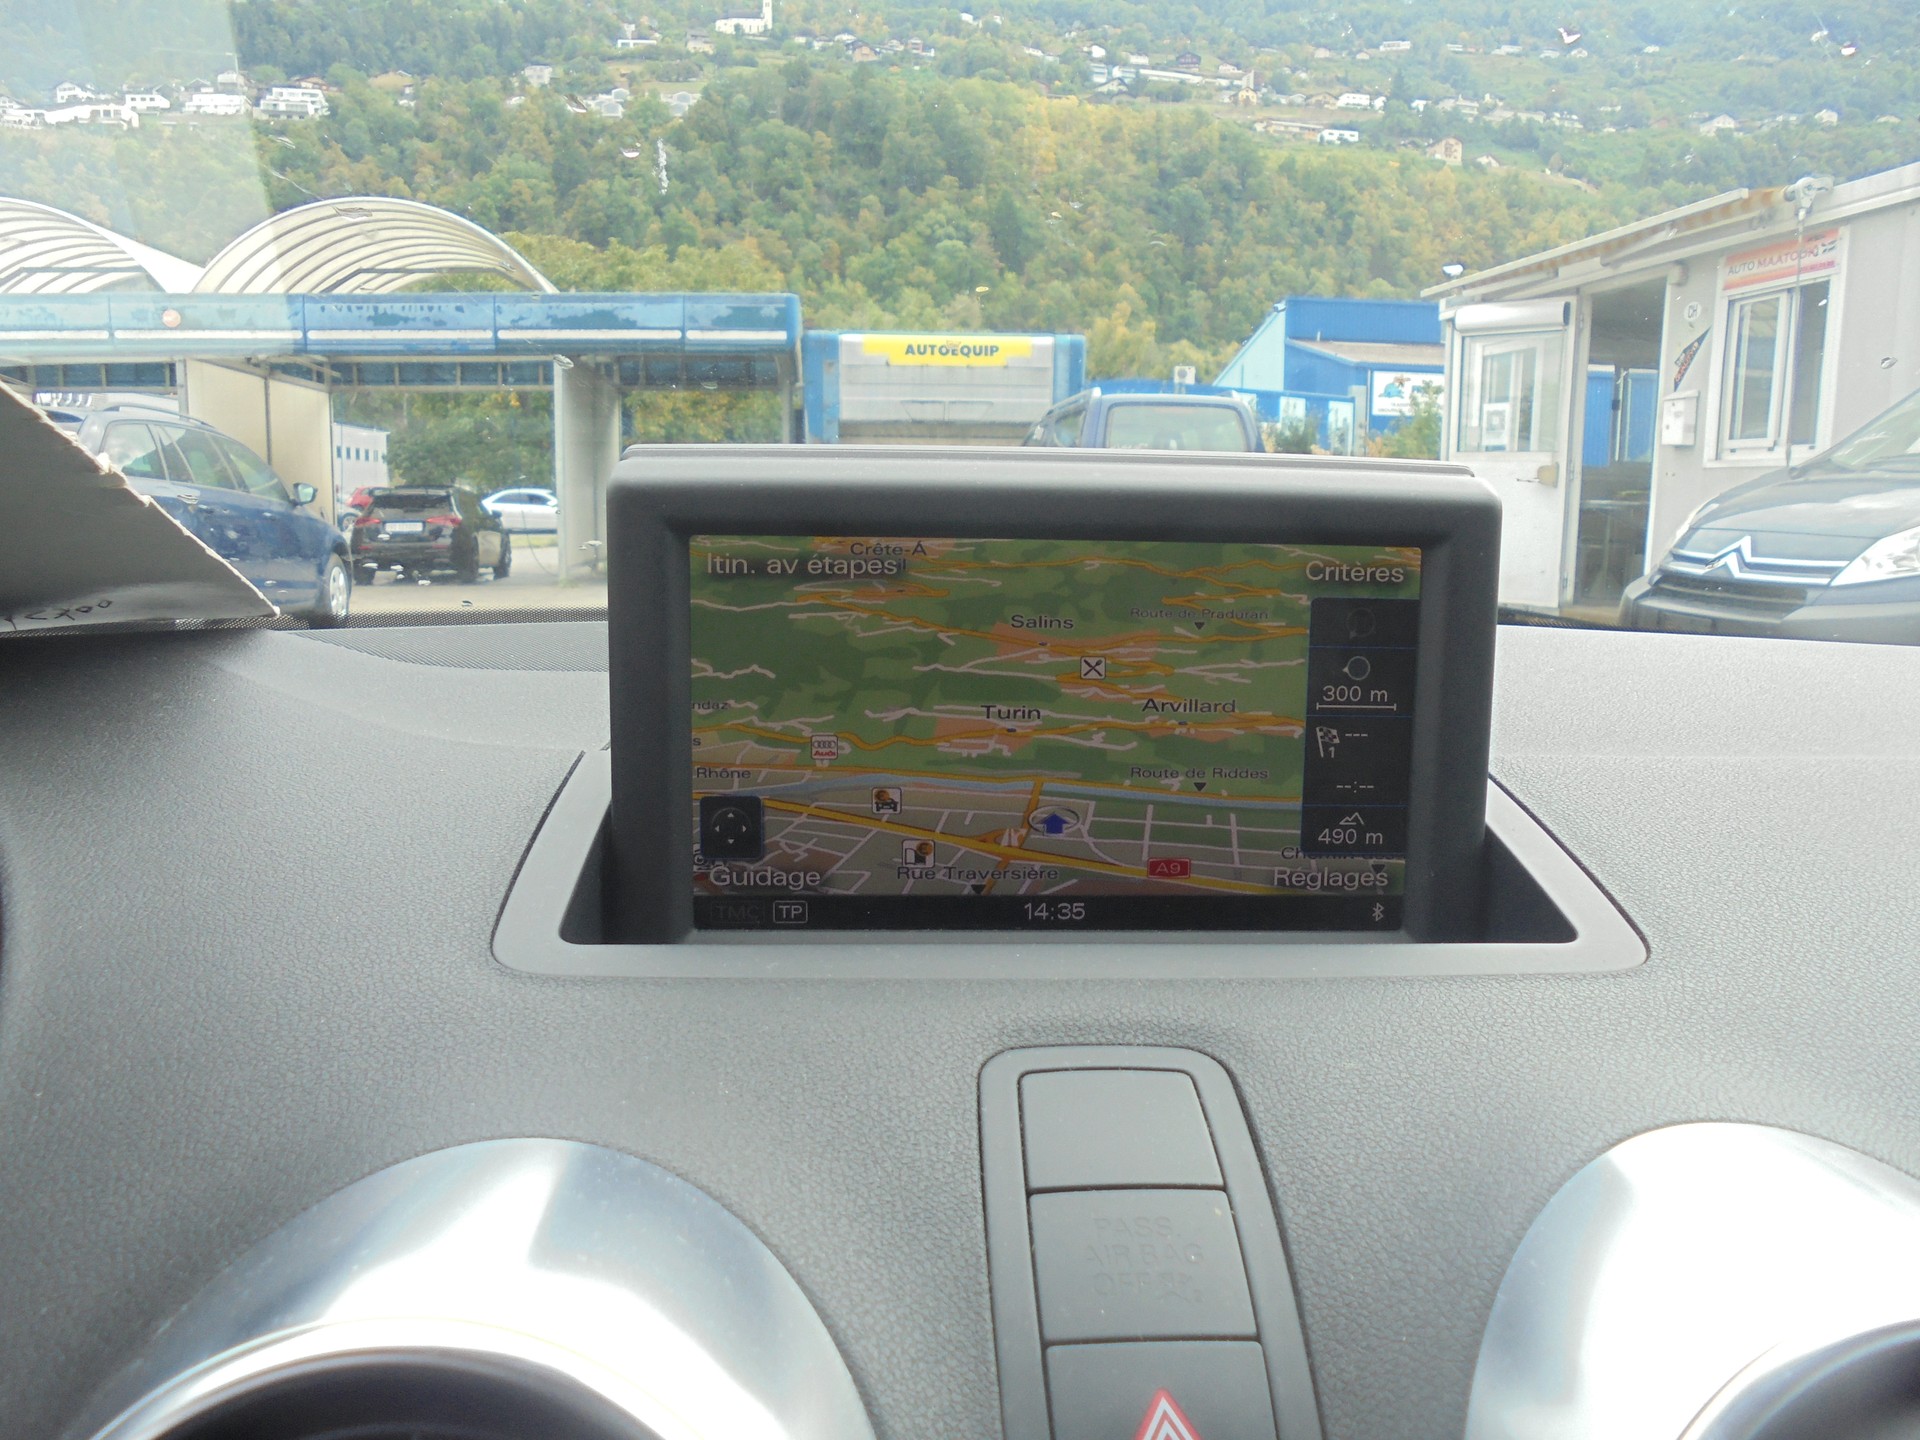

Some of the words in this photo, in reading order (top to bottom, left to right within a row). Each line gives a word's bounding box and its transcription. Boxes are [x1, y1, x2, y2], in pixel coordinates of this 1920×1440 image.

[1728, 261, 1755, 276] AUTO
[905, 344, 999, 358] AUTOEQUIP
[707, 552, 756, 574] Itin.
[767, 558, 799, 574] av
[807, 553, 898, 579] étapes
[1305, 560, 1405, 583] Critères
[1130, 607, 1173, 618] Route
[1178, 608, 1195, 618] de
[1011, 614, 1074, 629] Salins
[1322, 685, 1361, 702] 300
[1370, 689, 1388, 702] m
[981, 704, 1042, 719] Turin
[1142, 698, 1236, 713] Arvillard
[696, 767, 752, 779] Rhône
[1130, 767, 1180, 779] Route
[1186, 767, 1206, 779] de
[1212, 767, 1269, 779] Riddes
[1318, 828, 1357, 845] 490
[1366, 832, 1383, 844] m
[897, 866, 936, 880] Rue
[943, 866, 1059, 881] Traversière
[1155, 862, 1181, 874] A9
[709, 866, 821, 890] Guidage
[778, 905, 803, 920] TP
[1024, 902, 1086, 921] 14:35
